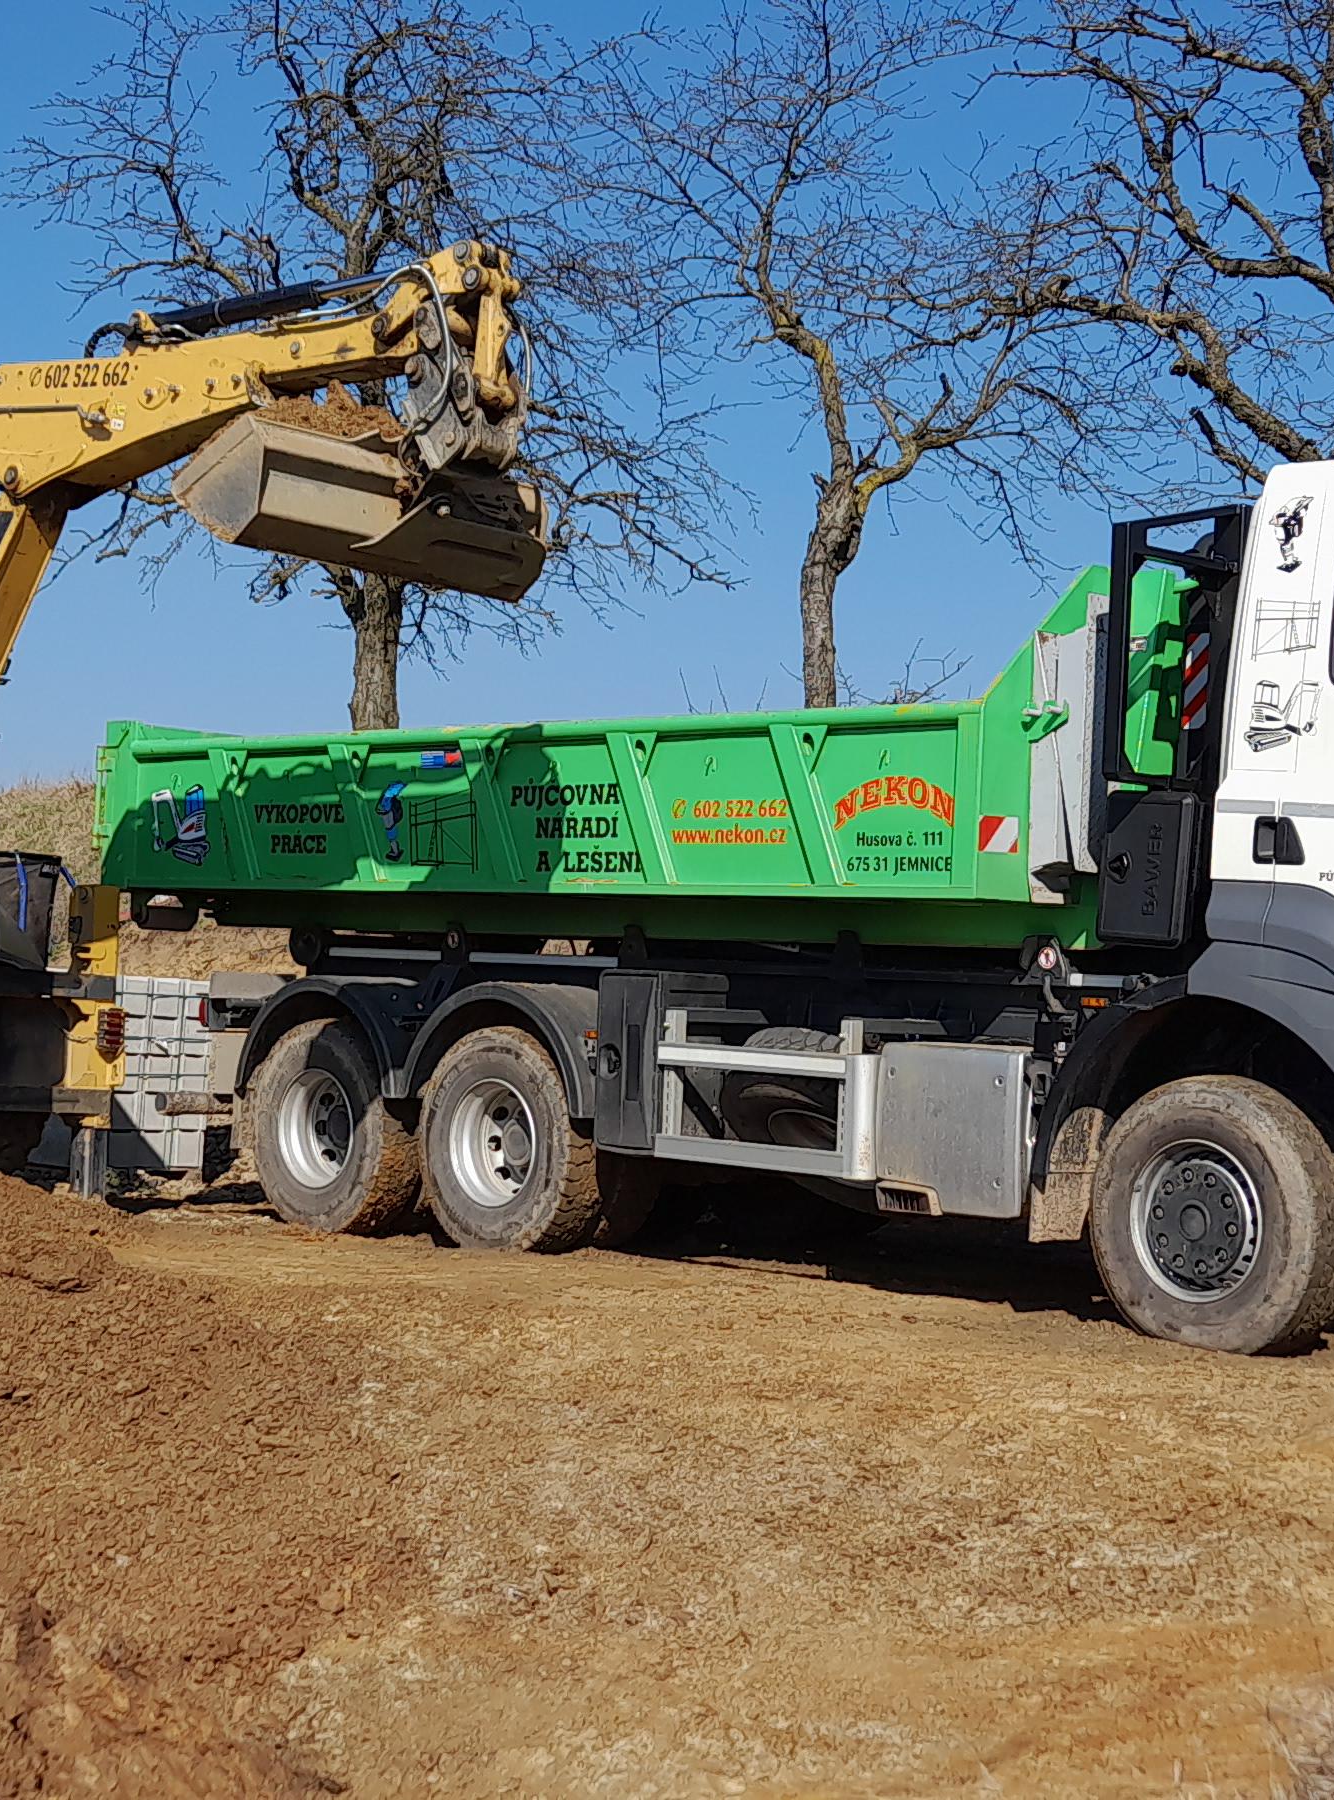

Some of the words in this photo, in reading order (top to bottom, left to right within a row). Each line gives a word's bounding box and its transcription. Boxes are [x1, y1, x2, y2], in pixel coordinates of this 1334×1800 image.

[45, 364, 70, 388] 602
[73, 363, 99, 387] 522
[103, 361, 129, 386] 662
[510, 778, 619, 811] PŮJČOVNA
[834, 776, 955, 831] NEKON
[694, 800, 720, 818] 602
[725, 800, 753, 817] 522
[758, 799, 787, 817] 662
[535, 811, 619, 838] NÁŘADÍ
[672, 822, 786, 843] www.nekon.cz
[271, 830, 327, 854] PRÁCE
[856, 832, 902, 846] Husova
[907, 830, 916, 846] č.
[923, 831, 943, 846] 111
[535, 850, 551, 872] A
[847, 856, 870, 871] 675
[873, 856, 888, 871] 31
[893, 856, 952, 876] JEMNICE
[1142, 824, 1162, 915] BAWER
